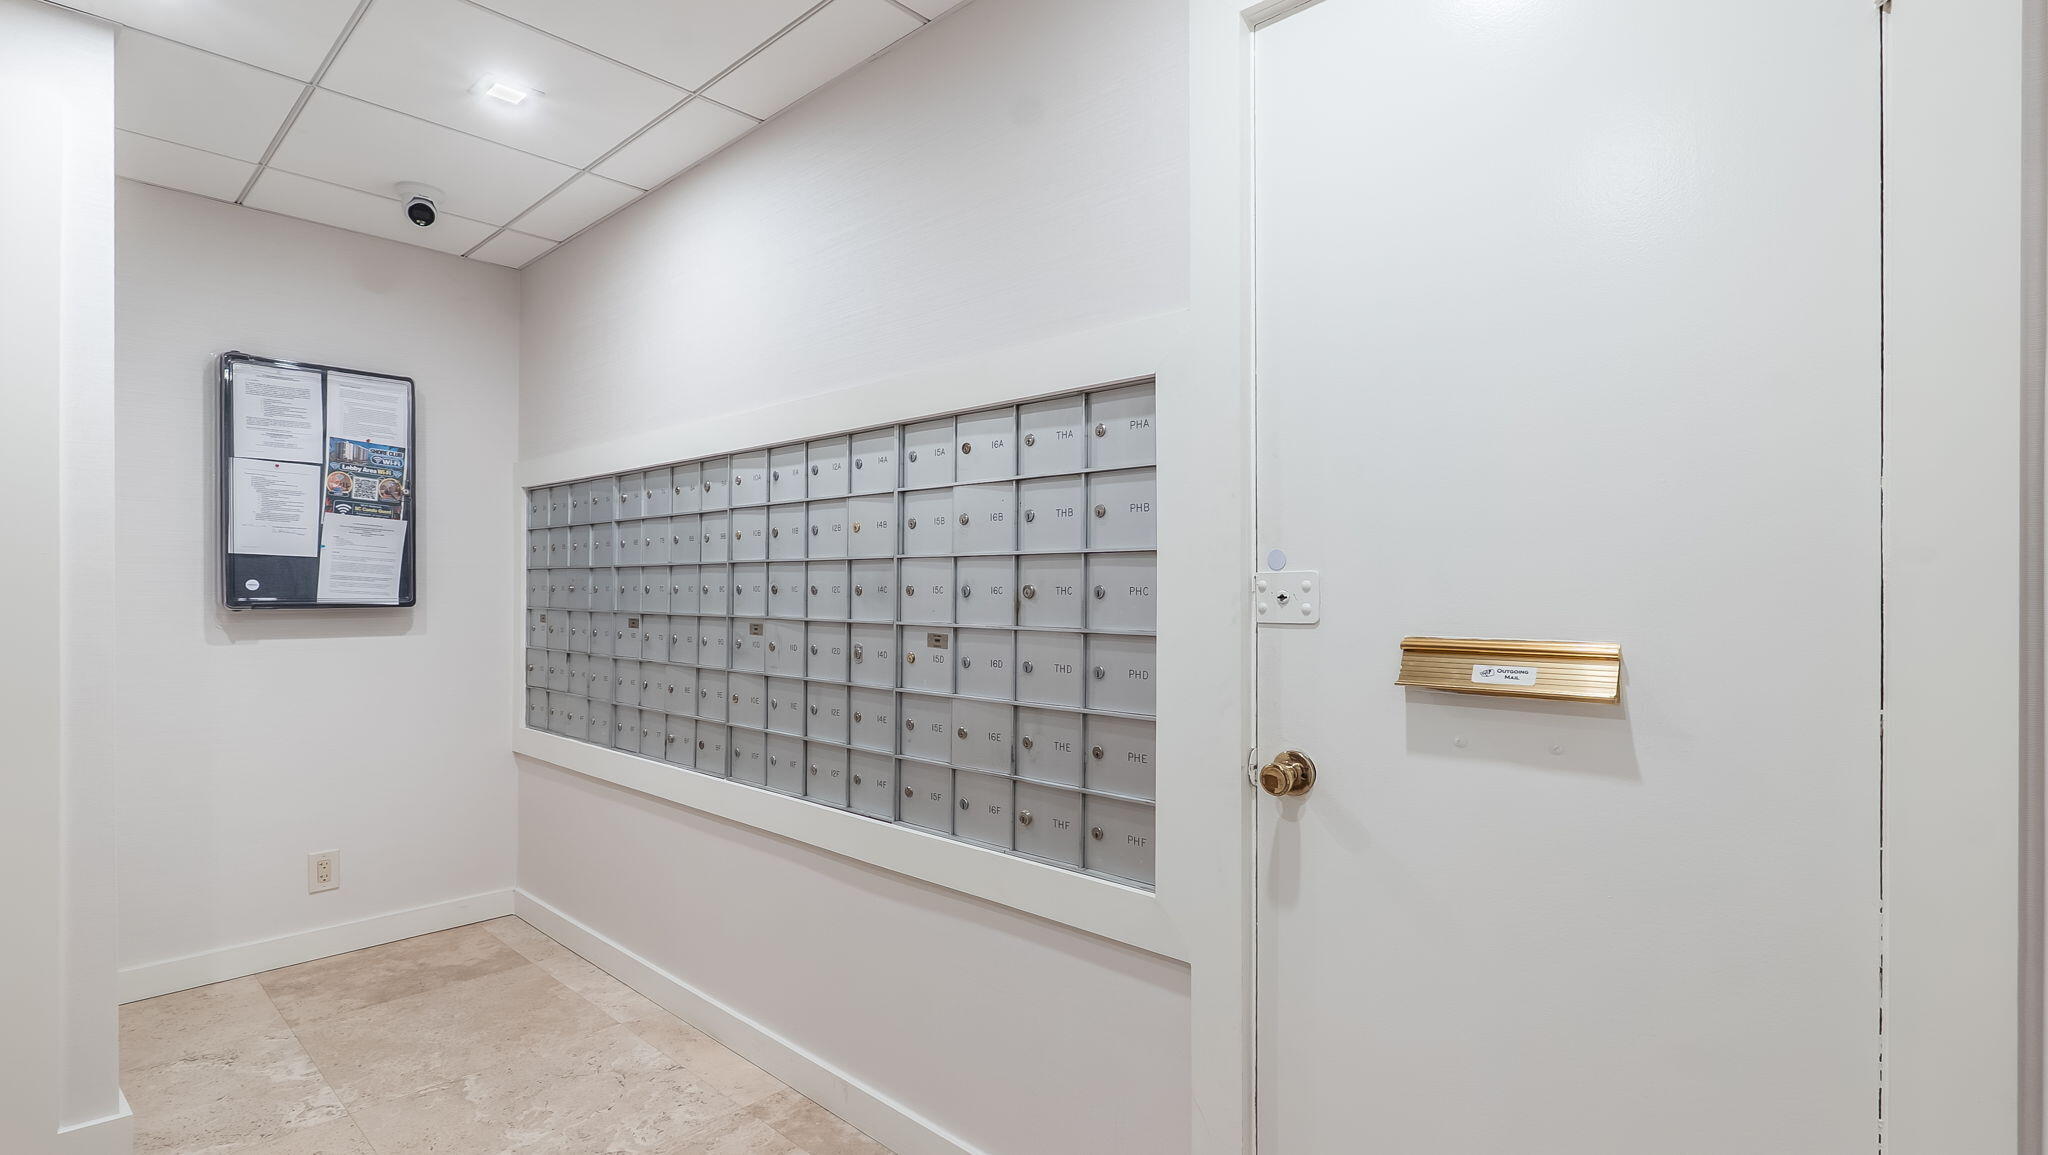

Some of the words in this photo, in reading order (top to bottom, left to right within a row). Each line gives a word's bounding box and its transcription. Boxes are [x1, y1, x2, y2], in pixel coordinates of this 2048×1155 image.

[1129, 418, 1150, 430] PHA
[1055, 429, 1074, 441] THA
[991, 439, 1005, 449] 16A
[934, 447, 946, 457] 15A
[877, 455, 889, 465] 14A
[341, 464, 362, 473] Lobby
[1055, 507, 1074, 518] THB
[1129, 502, 1151, 513] PHB
[933, 516, 946, 526] 15B
[989, 512, 1004, 522] 16B
[876, 520, 888, 529] 14B
[877, 585, 888, 594] 14C
[932, 585, 944, 595] 15C
[990, 585, 1004, 595] 16C
[1055, 585, 1073, 596] THC
[1129, 586, 1149, 597] PHC
[877, 650, 888, 660] 14D
[932, 654, 945, 664] 15D
[990, 659, 1004, 669] 16D
[1053, 663, 1073, 674] THD
[1128, 668, 1149, 681] PHD
[876, 714, 888, 724] 14E
[931, 723, 944, 733] 15E
[988, 731, 1002, 743] 16E
[1053, 741, 1072, 753] THE
[1127, 751, 1149, 764] PHE
[876, 779, 887, 789] 14F
[930, 792, 942, 802] 15F
[988, 804, 1002, 815] 16F
[1051, 818, 1071, 830] THF
[1127, 834, 1148, 848] PHF
